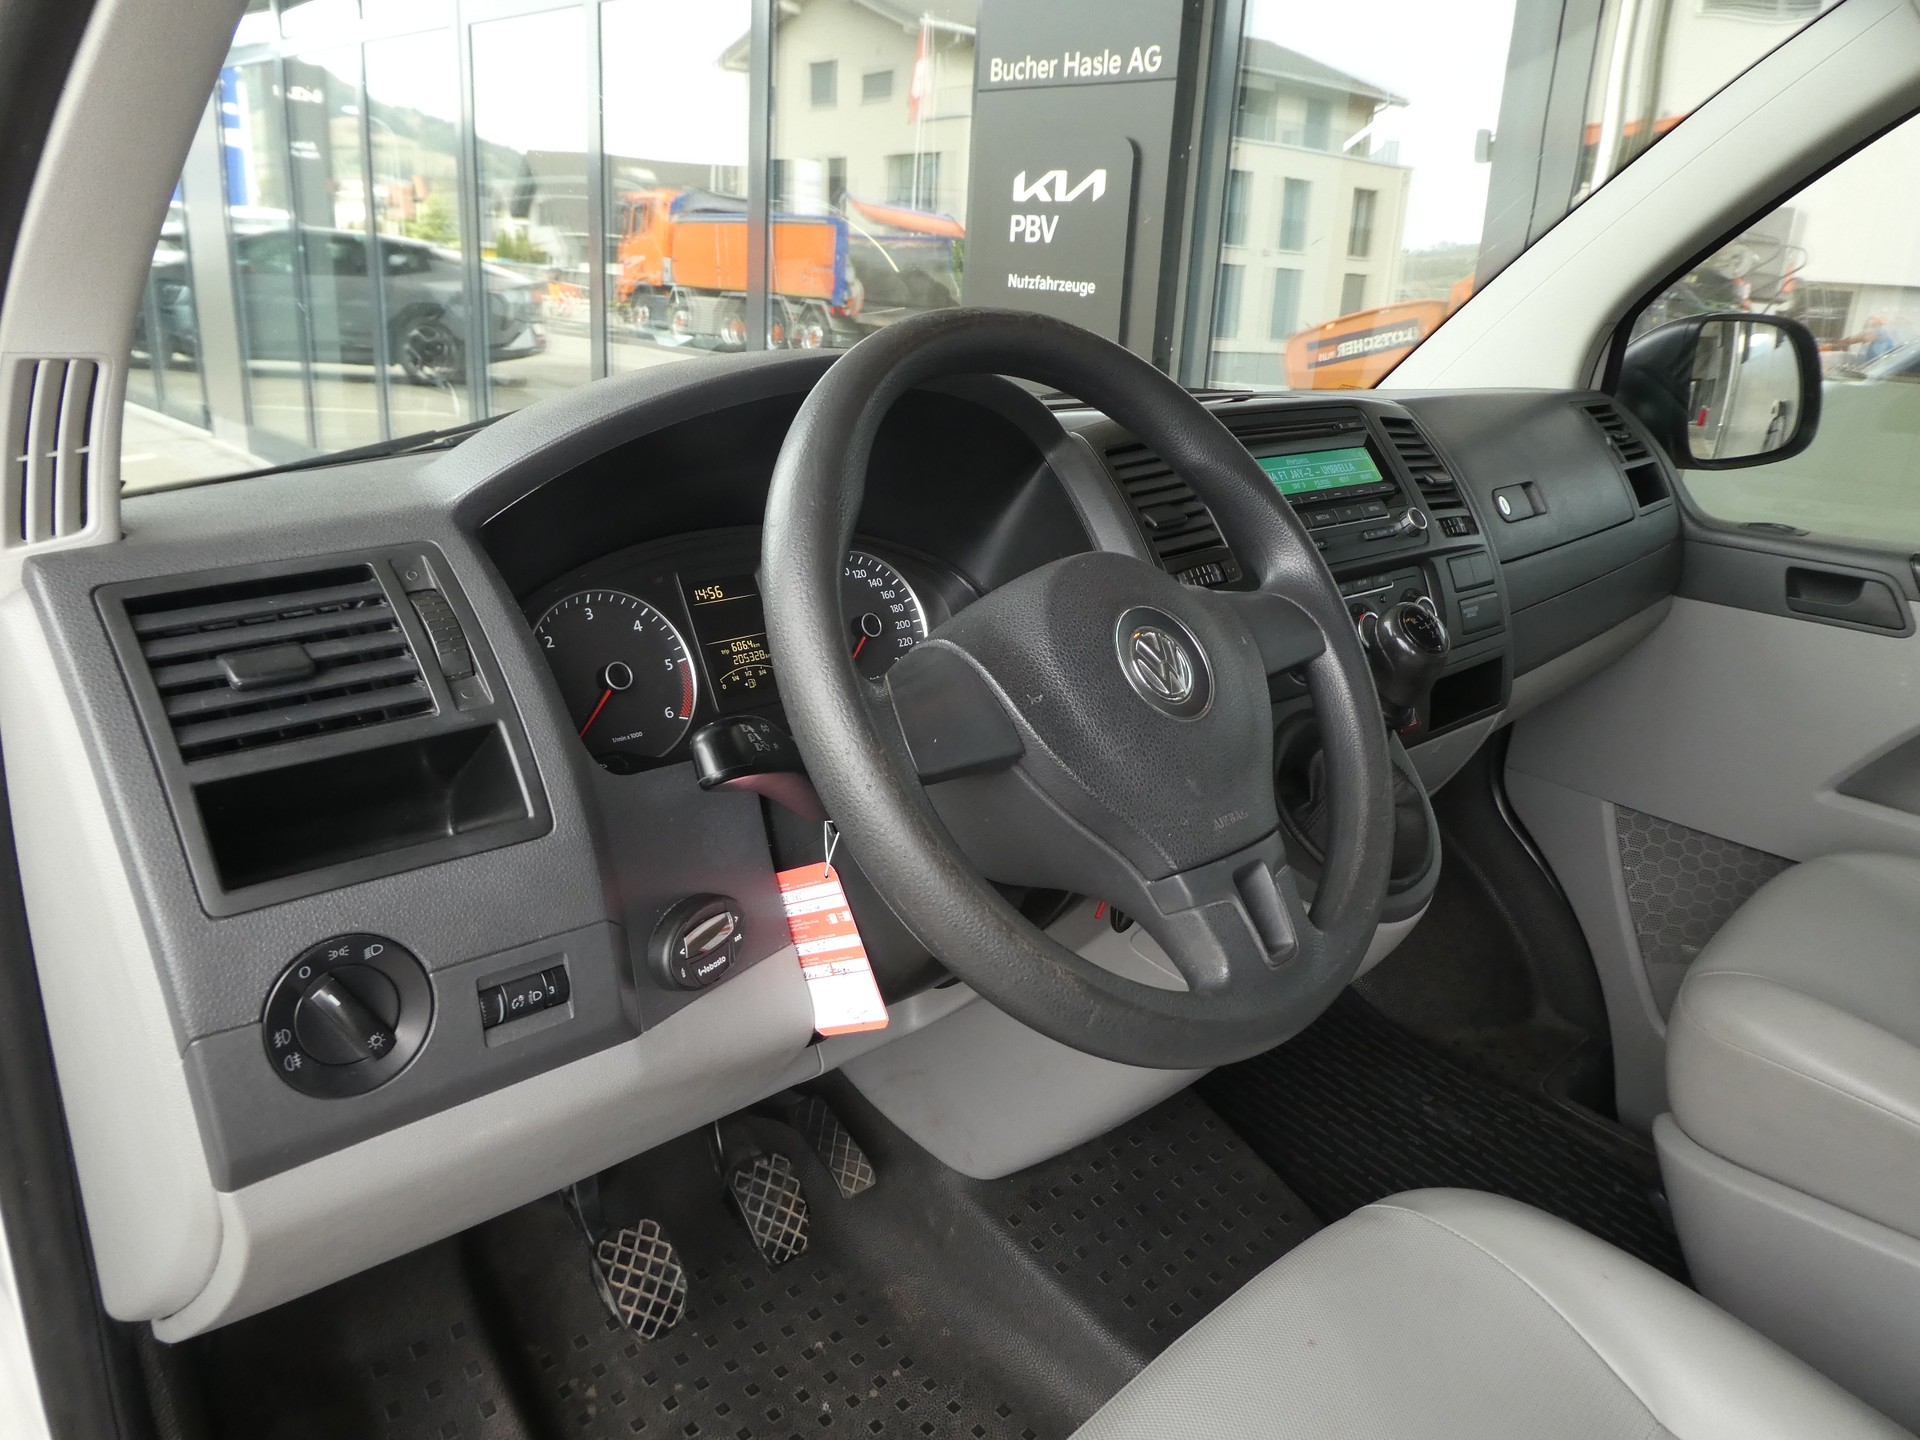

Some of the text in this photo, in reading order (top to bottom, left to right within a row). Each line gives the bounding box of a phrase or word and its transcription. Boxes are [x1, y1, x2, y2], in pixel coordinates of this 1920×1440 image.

[990, 45, 1162, 82] Bucher Hasle AG
[1012, 169, 1107, 202] KIA
[1009, 214, 1059, 244] PBV
[1007, 273, 1096, 297] Nutzfahrzeuge
[1278, 470, 1289, 480] FT
[1320, 462, 1356, 475] UMBRELLA
[852, 569, 867, 579] 120
[868, 578, 883, 588] 140
[694, 585, 723, 601] 14:56
[880, 590, 895, 600] 160
[584, 608, 593, 620] 3
[890, 603, 904, 613] 180
[633, 620, 643, 632] 4
[895, 620, 910, 630] 200
[544, 636, 555, 648] 2
[897, 637, 913, 647] 220
[733, 650, 765, 665] 205328
[664, 659, 673, 671] 5
[664, 707, 674, 718] 6
[630, 731, 643, 739] 1000
[697, 956, 727, 977] Webasto
[549, 985, 556, 995] 3
